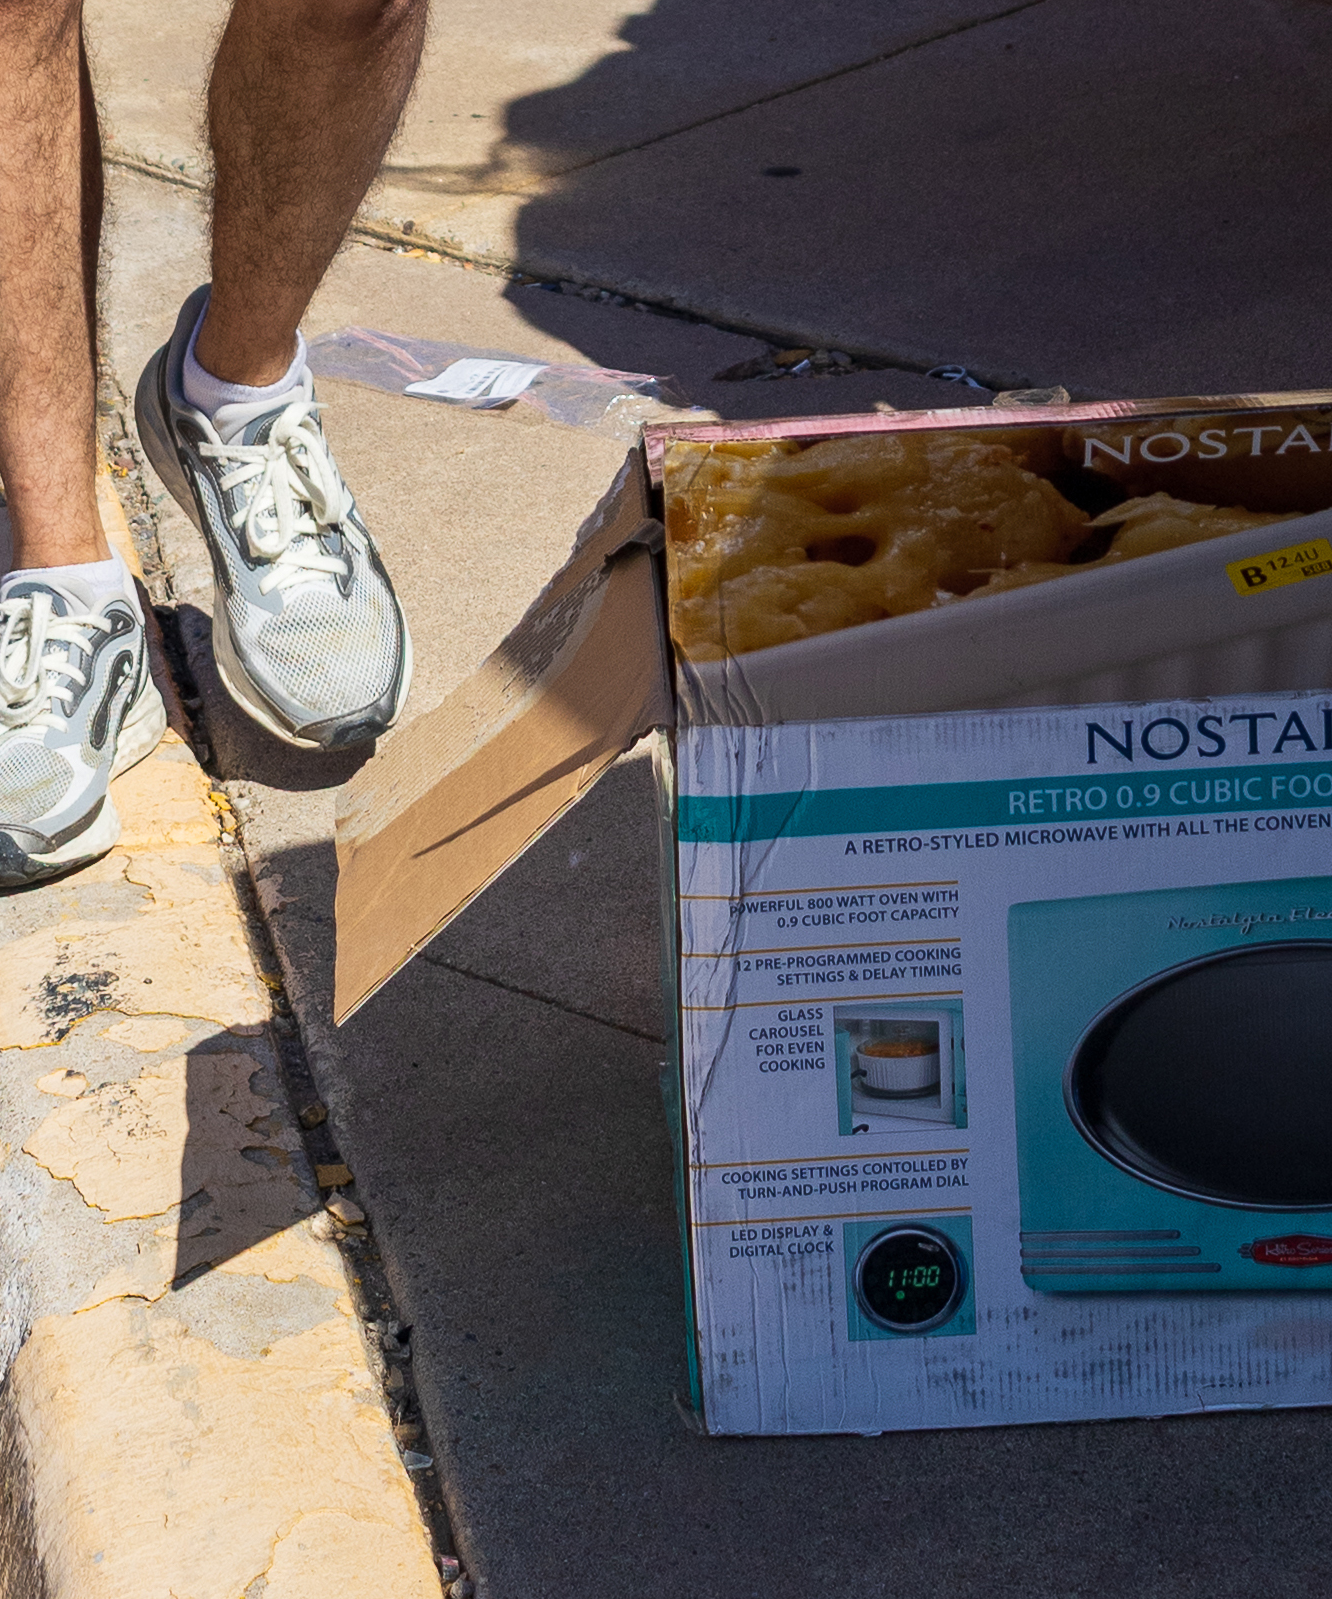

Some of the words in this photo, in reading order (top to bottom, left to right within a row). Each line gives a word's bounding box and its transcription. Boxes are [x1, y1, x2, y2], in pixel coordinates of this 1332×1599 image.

[1240, 566, 1267, 587] B
[1009, 786, 1108, 815] RETRO
[1117, 784, 1160, 809] 0.9
[1169, 777, 1261, 805] CUBIC
[844, 841, 858, 855] A
[862, 832, 999, 855] RETRO-STYLED
[1005, 825, 1119, 847] MICROWAVE
[1122, 822, 1170, 839] WITH
[1176, 821, 1209, 836] ALL
[1213, 817, 1249, 834] THE
[729, 898, 804, 919] POWERFUL
[807, 897, 833, 909] 800
[836, 895, 876, 908] WATT
[878, 891, 918, 905] OVEN
[921, 890, 959, 903] WITH
[777, 916, 798, 928] 0.9
[801, 913, 845, 927] CUBIC
[849, 911, 887, 924] FOOT
[891, 906, 959, 922] CAPACITY
[735, 961, 752, 972] 12
[756, 952, 891, 971] PRE-PROGRAMMED
[895, 948, 961, 962] COOKING
[777, 970, 845, 986] SETTINGS
[848, 968, 859, 981] &
[863, 966, 906, 980] DELAY
[910, 963, 962, 977] TIMING
[778, 1008, 823, 1022] GLASS
[749, 1024, 824, 1040] CAROUSEL
[756, 1043, 785, 1057] FOR
[788, 1040, 825, 1055] EVEN
[759, 1057, 825, 1073] COOKING
[722, 1169, 788, 1184] COOKING
[791, 1165, 858, 1181] SETTINGS
[862, 1159, 946, 1176] CONTOLLED
[951, 1157, 969, 1171] BY
[738, 1177, 857, 1200] TURN-AND-PUSH
[861, 1177, 932, 1193] PROGRAM
[936, 1174, 970, 1187] DIAL
[732, 1228, 758, 1241] LED
[762, 1225, 819, 1240] DISPLAY
[823, 1225, 834, 1235] &
[729, 1243, 784, 1258] DIGITAL
[788, 1241, 834, 1254] CLOCK
[888, 1266, 940, 1287] 11:00
